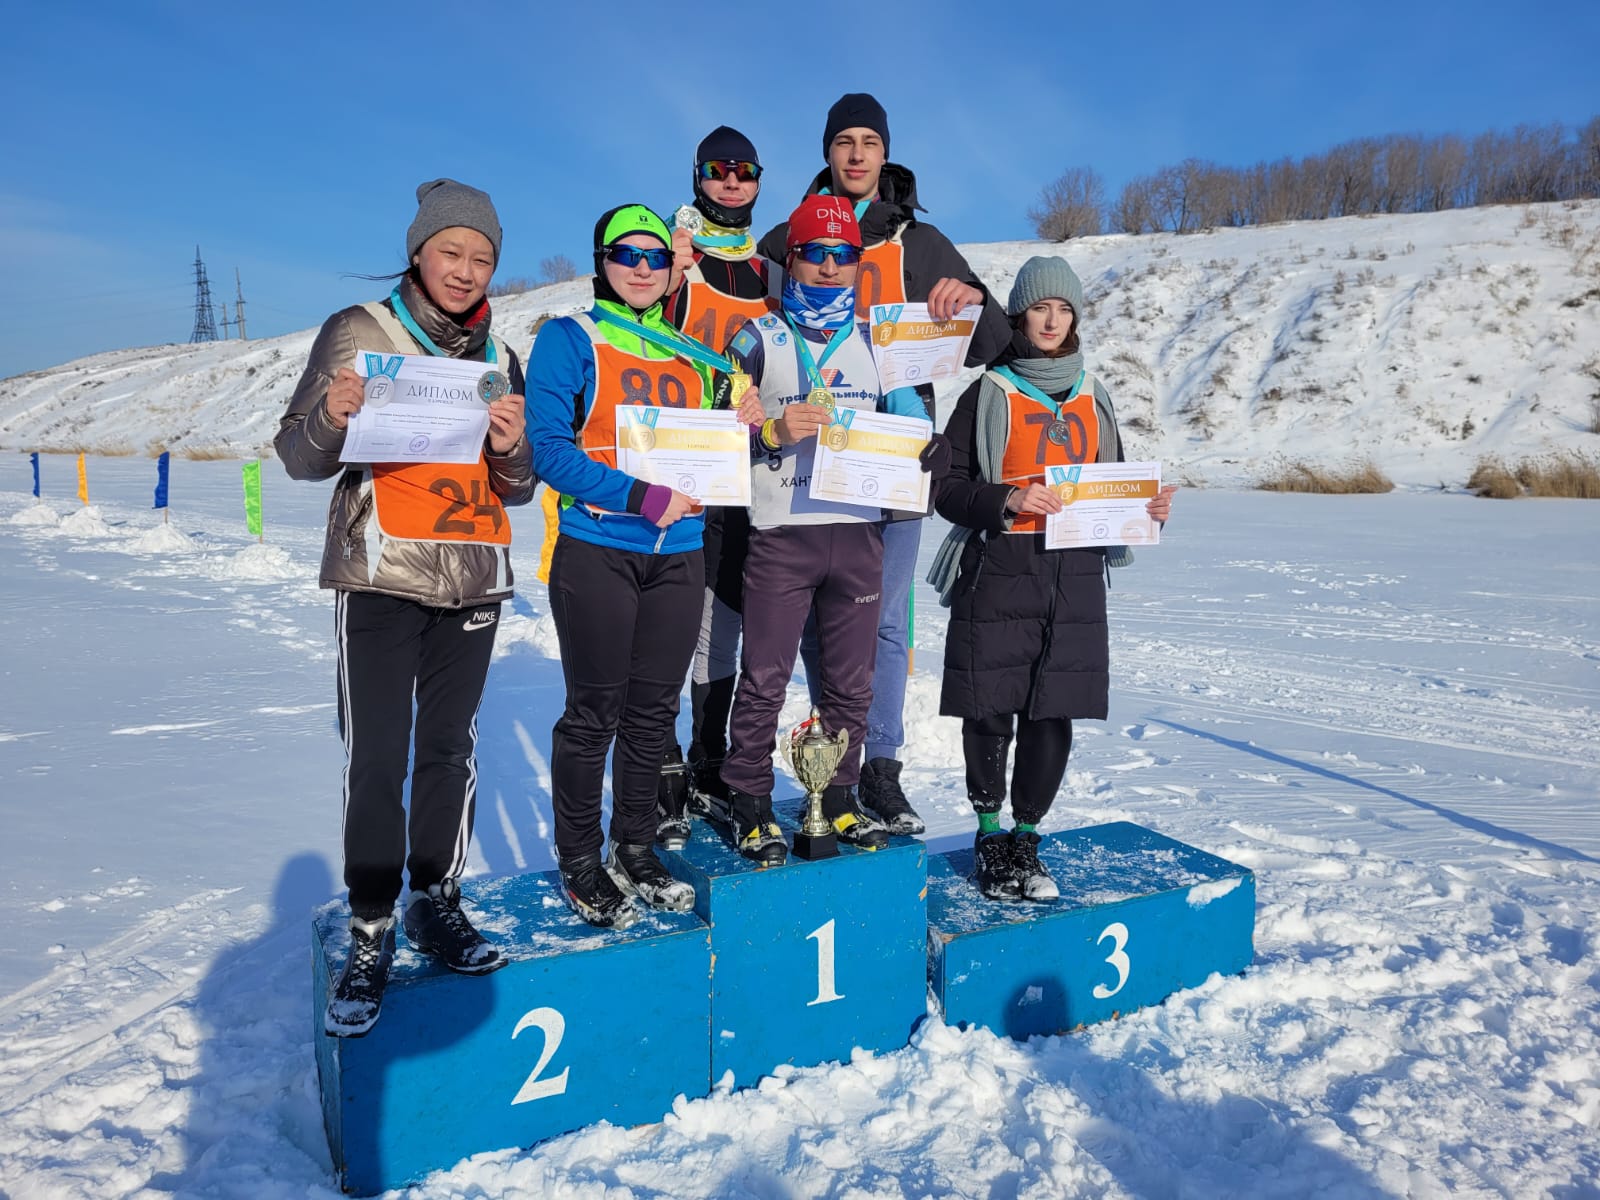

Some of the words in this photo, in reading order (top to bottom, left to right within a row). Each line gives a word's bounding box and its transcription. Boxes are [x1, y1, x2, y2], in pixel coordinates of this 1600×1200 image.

[816, 208, 851, 223] DNB
[905, 322, 957, 336] ДИПЛОМ
[406, 384, 474, 402] ДИПЛОМ
[1024, 412, 1088, 464] 70
[1087, 483, 1141, 495] ДИПЛОМ
[429, 478, 503, 535] 24
[855, 592, 880, 604] EVENT
[472, 611, 496, 622] NIKE
[806, 918, 845, 1007] 1
[1092, 922, 1131, 1000] 3
[511, 1006, 571, 1106] 2
